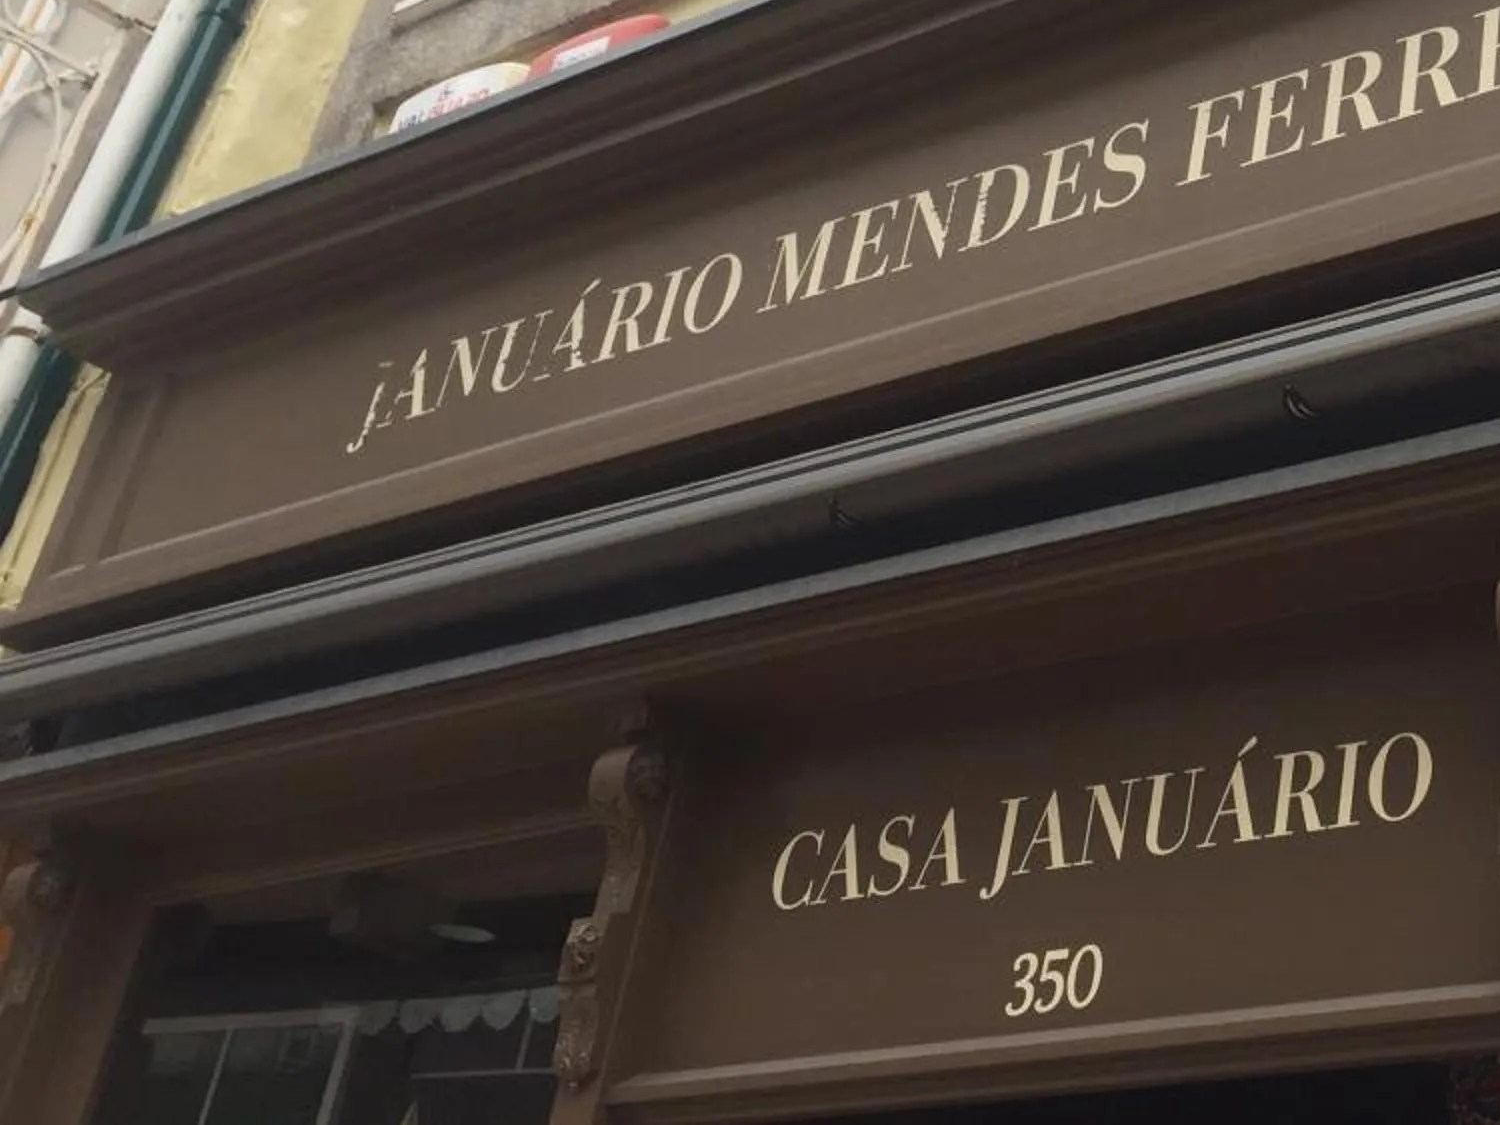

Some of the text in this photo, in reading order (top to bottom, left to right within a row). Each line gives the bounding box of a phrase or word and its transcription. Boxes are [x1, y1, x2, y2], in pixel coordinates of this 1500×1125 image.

[346, 253, 743, 454] JANUÁRIO
[755, 118, 1149, 314] MENDES
[772, 732, 1434, 911] CASA JANUÁRIO
[1004, 943, 1103, 1017] 350
